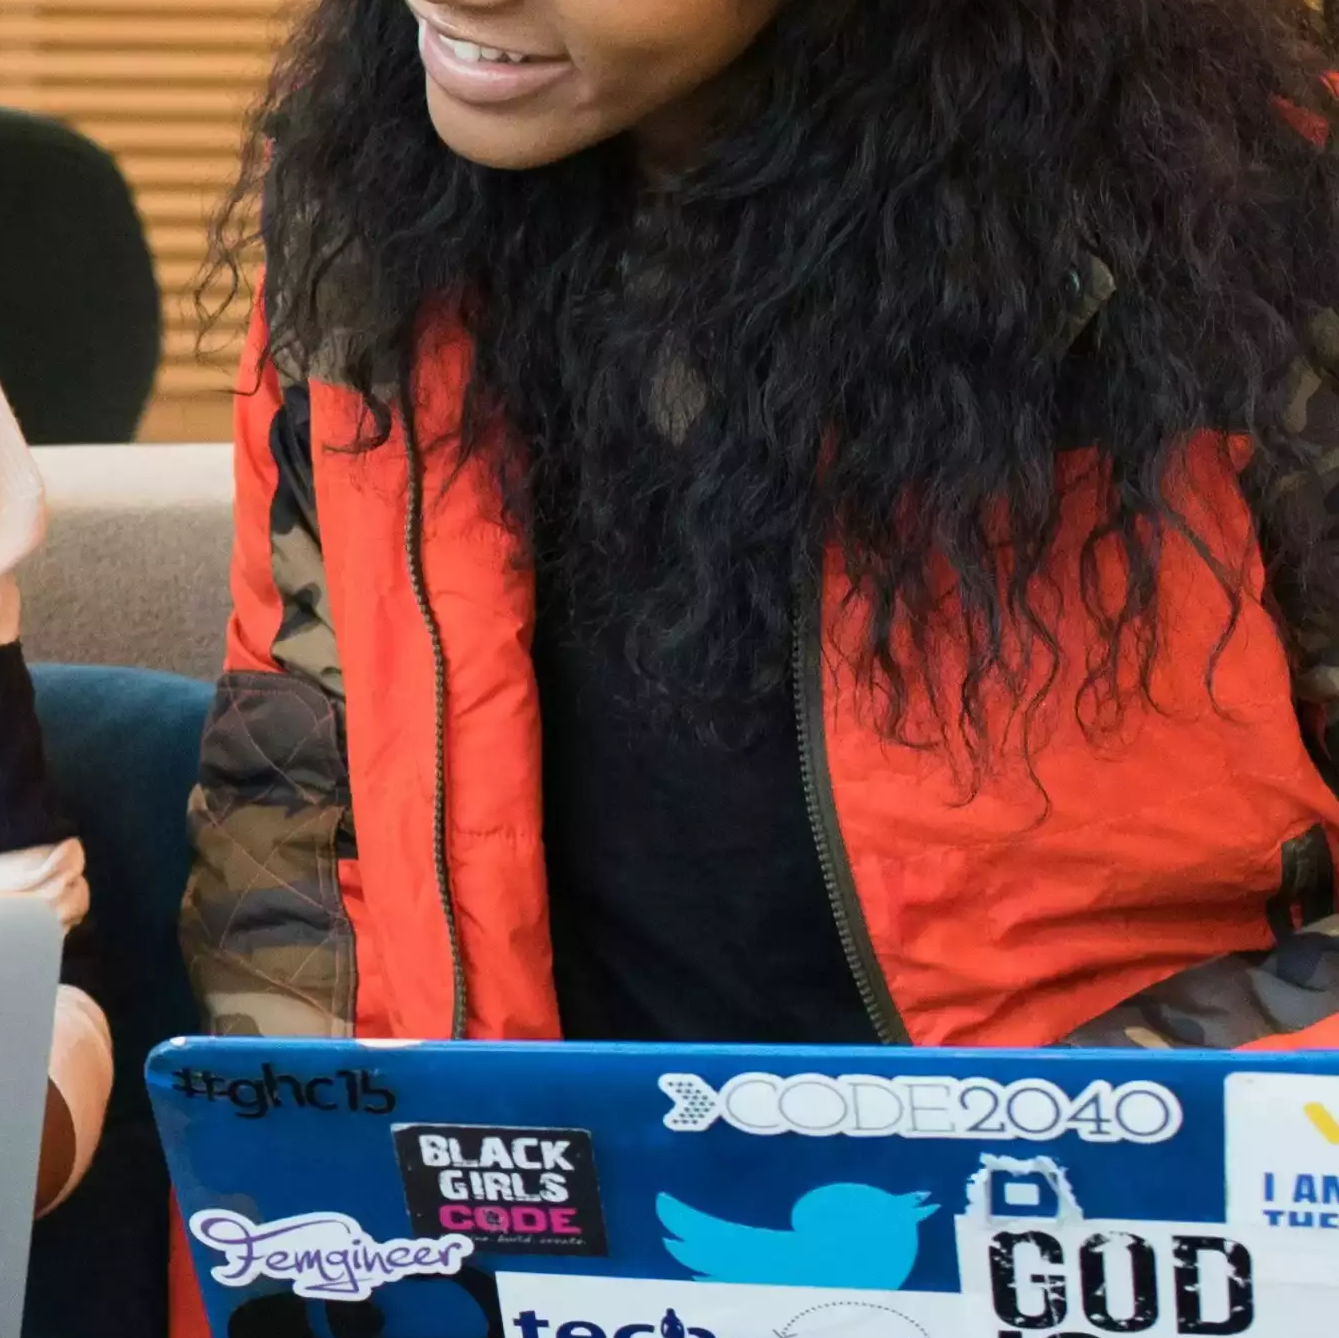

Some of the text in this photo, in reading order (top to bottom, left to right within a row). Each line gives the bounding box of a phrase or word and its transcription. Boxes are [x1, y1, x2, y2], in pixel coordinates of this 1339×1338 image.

[725, 1078, 1170, 1136] CODE2040
[418, 1134, 575, 1170] BLACK
[438, 1169, 570, 1203] GIRLS
[438, 1204, 582, 1234] CODE
[200, 1217, 463, 1294] Femgineer
[988, 1230, 1255, 1336] GOD
